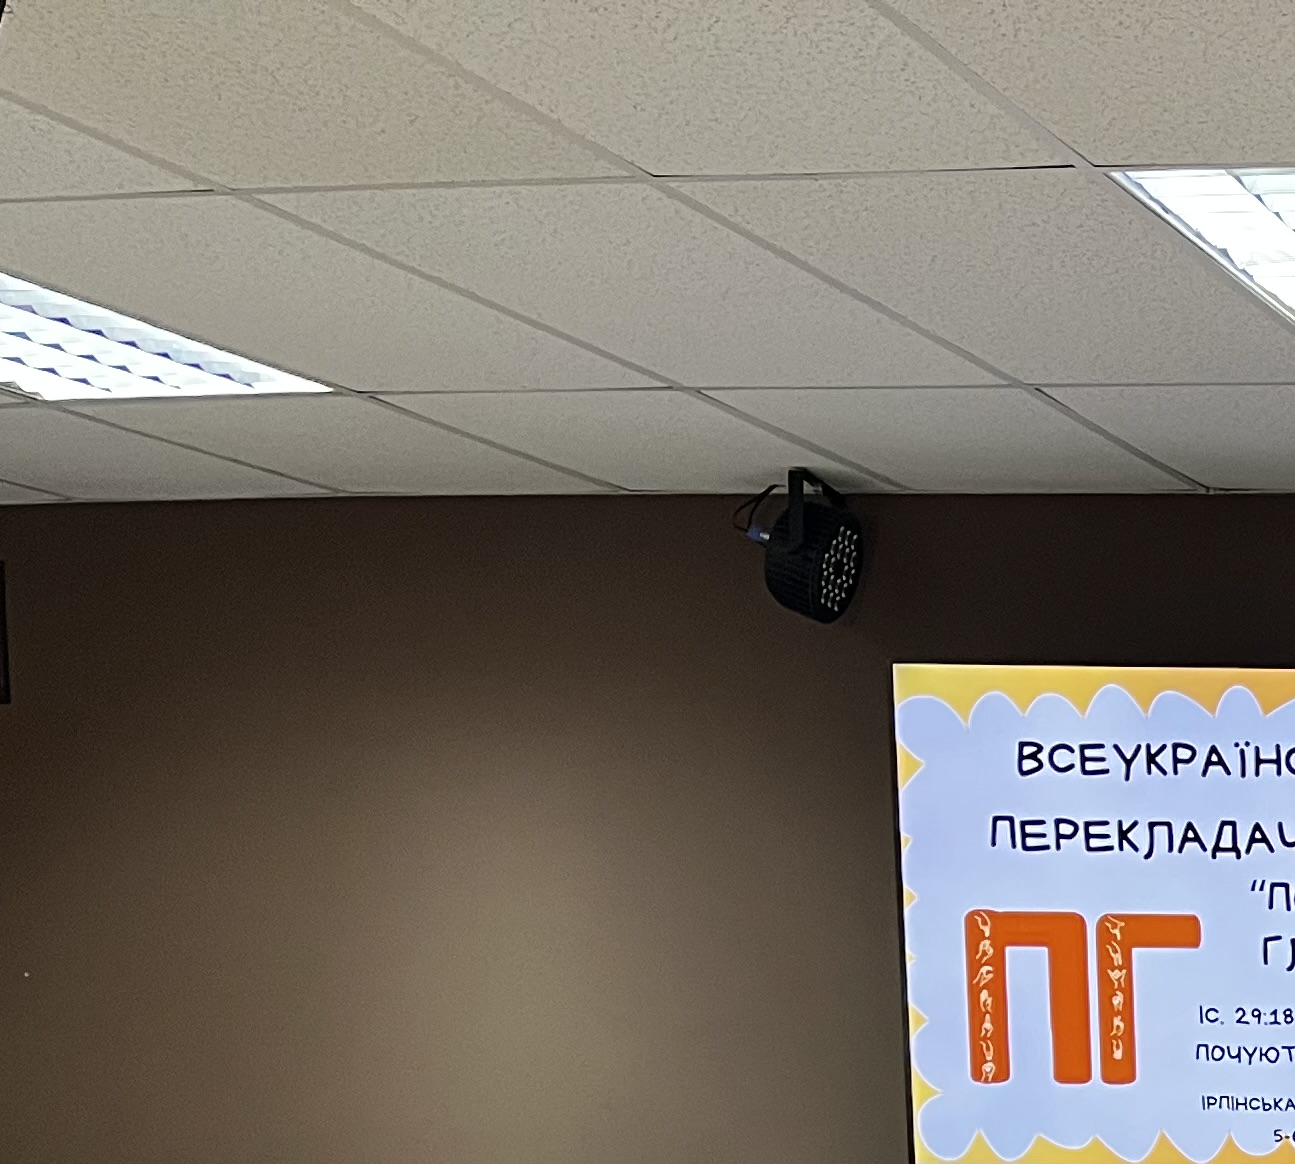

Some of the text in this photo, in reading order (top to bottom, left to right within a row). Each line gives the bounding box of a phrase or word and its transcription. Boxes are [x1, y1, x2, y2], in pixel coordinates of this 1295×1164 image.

[964, 909, 1202, 1084] ПГ
[1199, 1004, 1225, 1025] ІС.
[1234, 1007, 1295, 1026] 29:18
